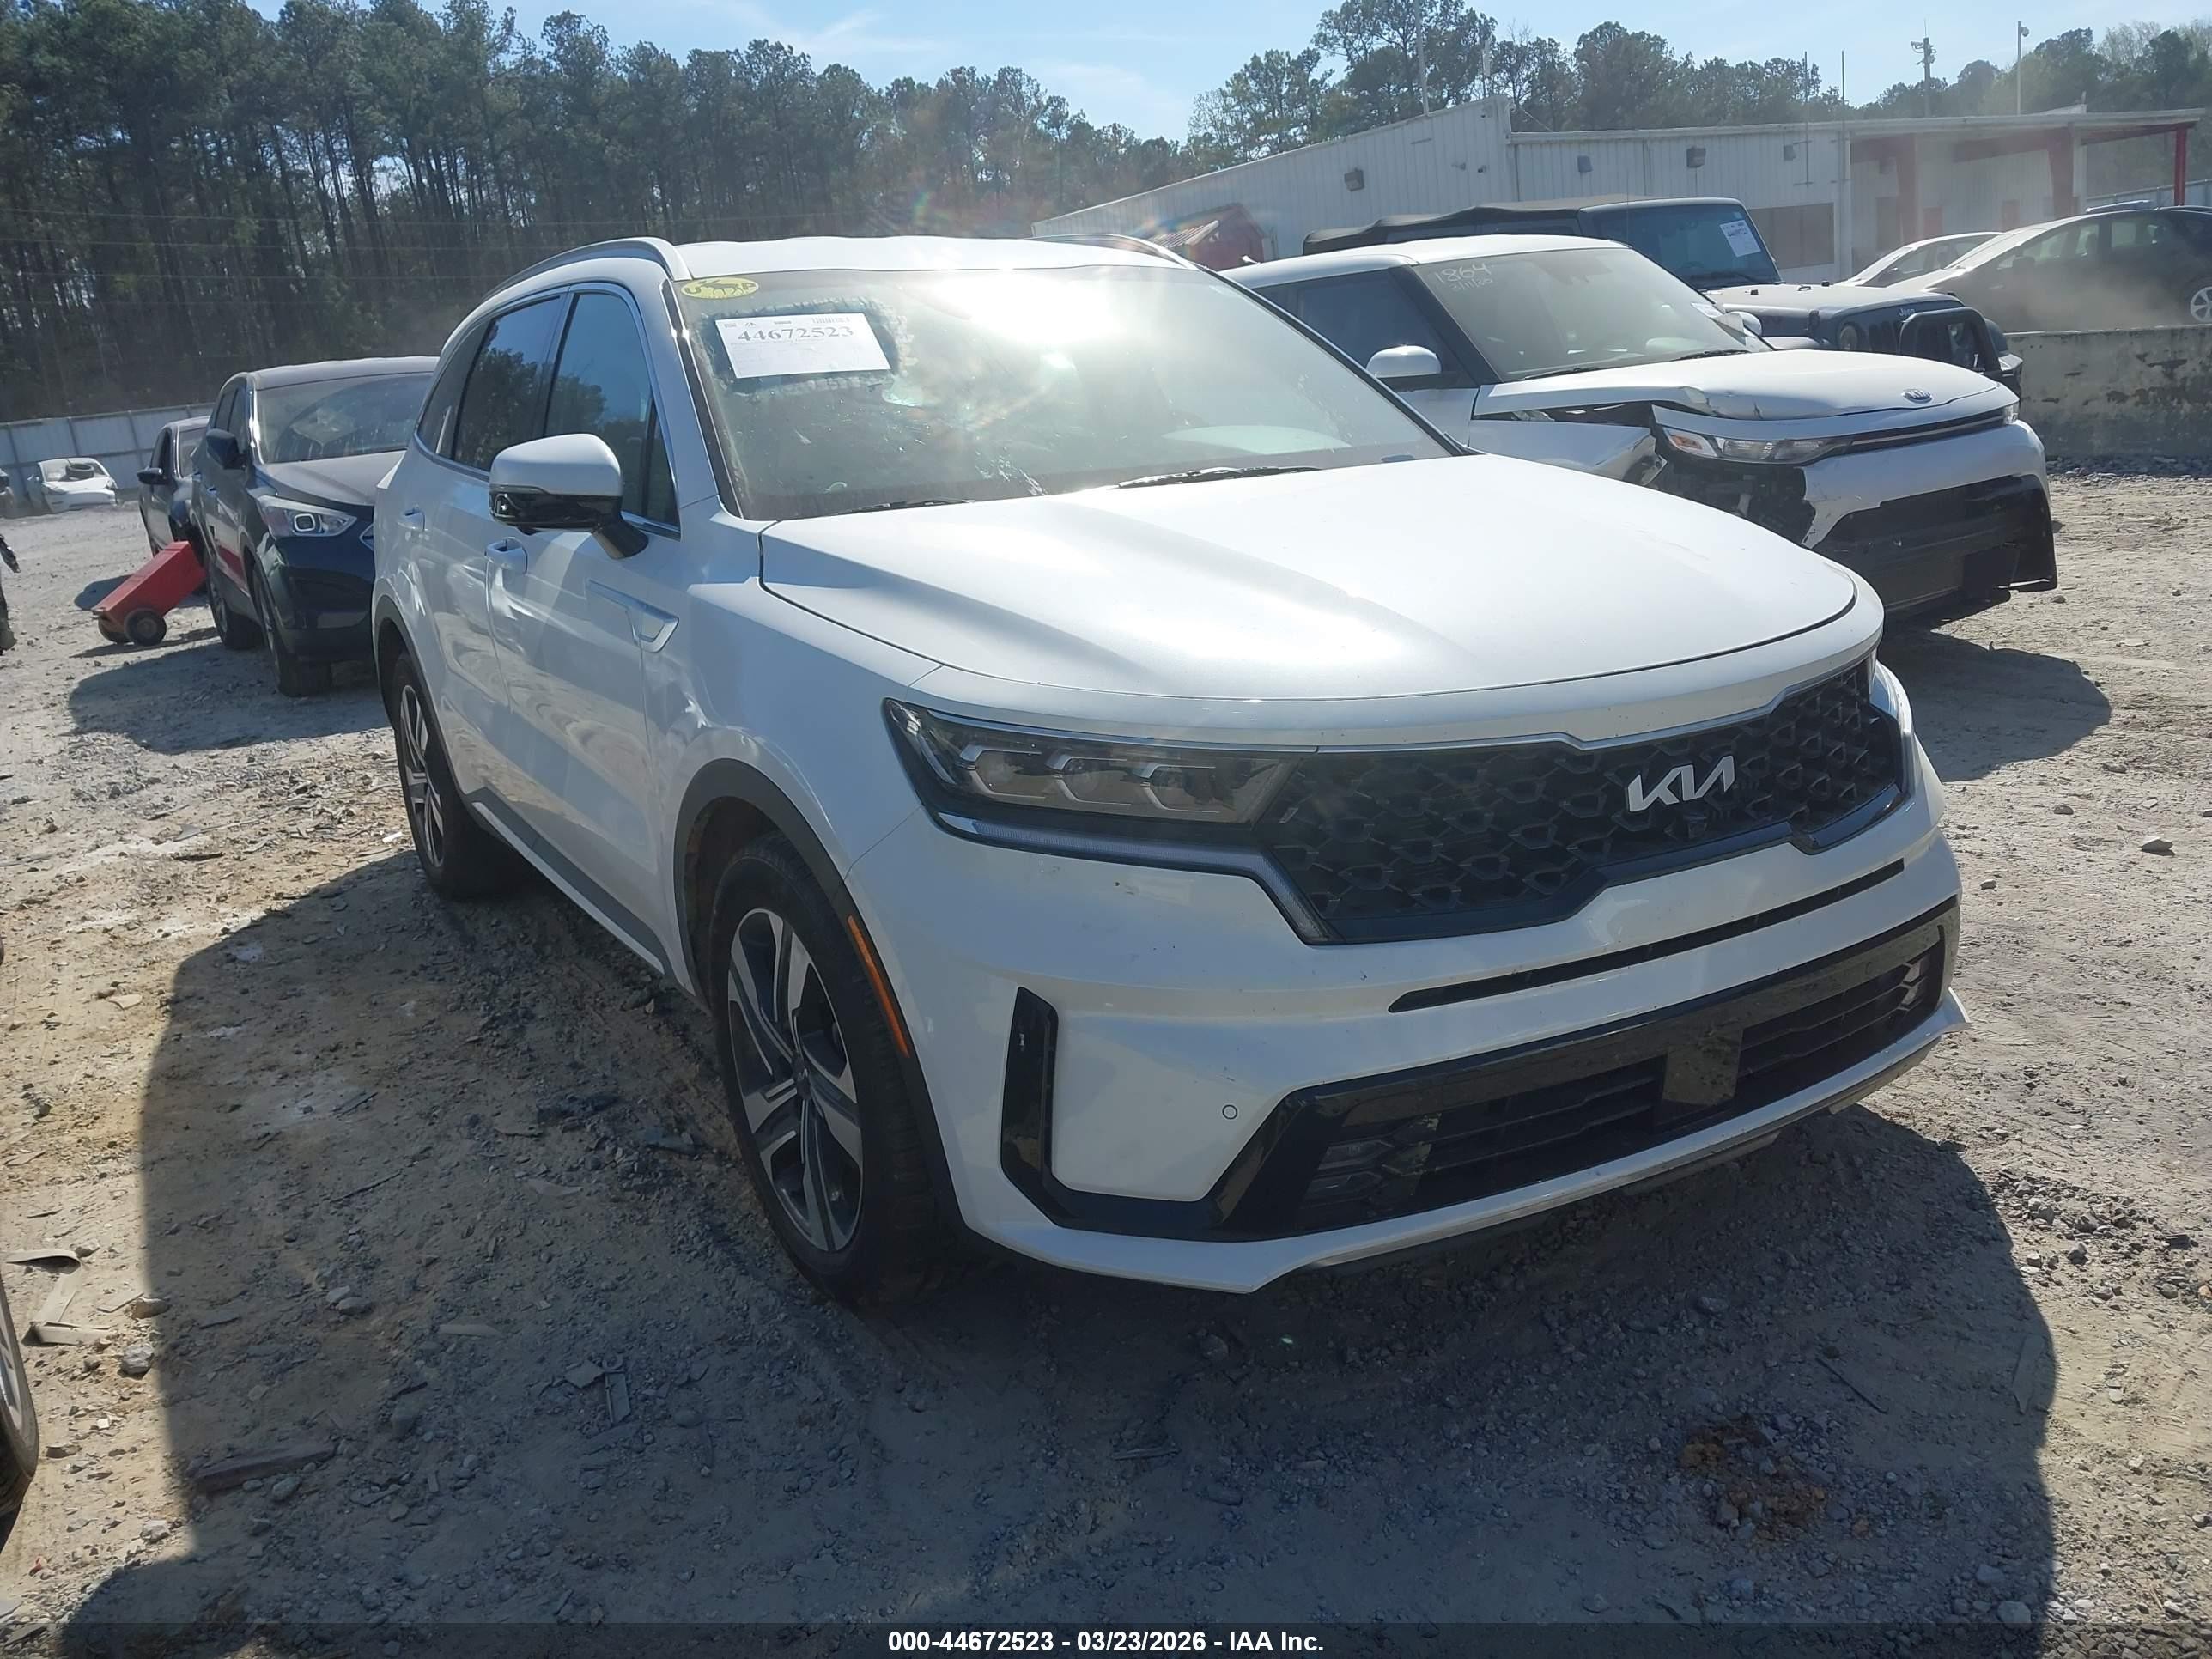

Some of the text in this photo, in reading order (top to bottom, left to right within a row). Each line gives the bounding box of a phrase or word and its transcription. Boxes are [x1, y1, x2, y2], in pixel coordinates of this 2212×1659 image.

[1435, 263, 1492, 283] 1864
[738, 325, 854, 342] 44672523
[1627, 755, 1735, 812] KIA
